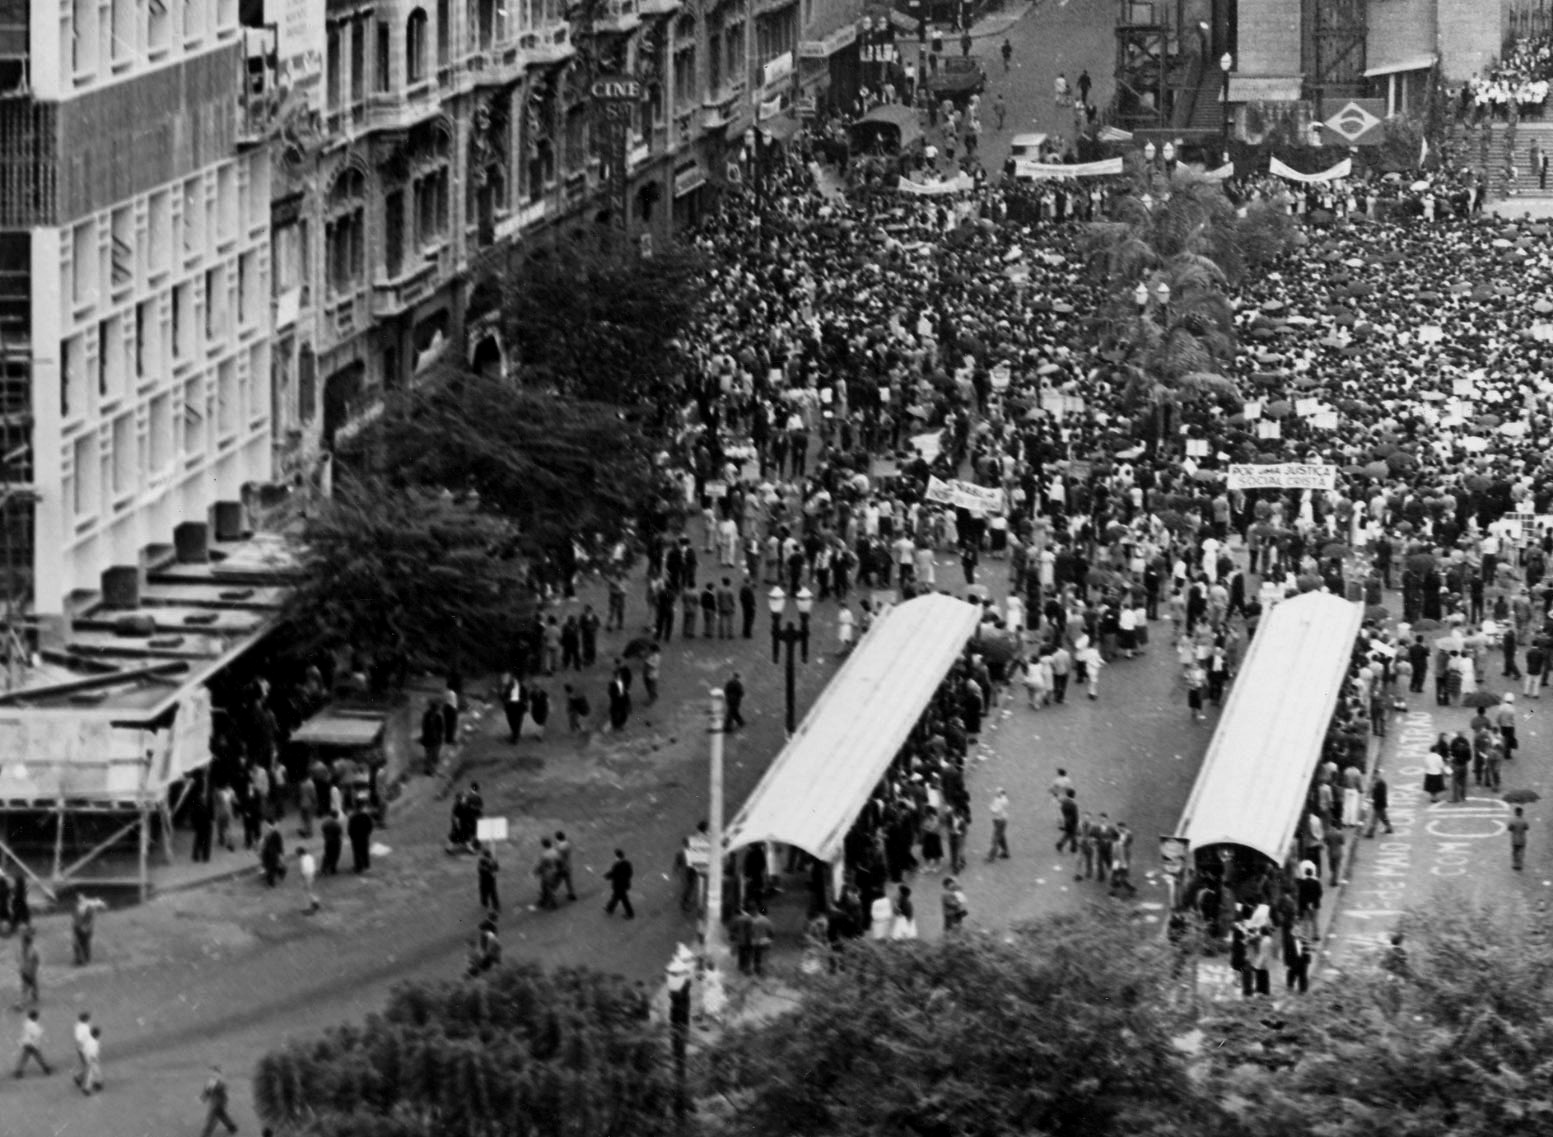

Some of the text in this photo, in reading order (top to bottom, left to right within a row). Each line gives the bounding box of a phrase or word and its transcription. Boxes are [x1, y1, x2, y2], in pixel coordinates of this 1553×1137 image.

[591, 81, 641, 98] CINE
[1240, 476, 1283, 486] SOCIAL
[1430, 841, 1473, 877] COM
